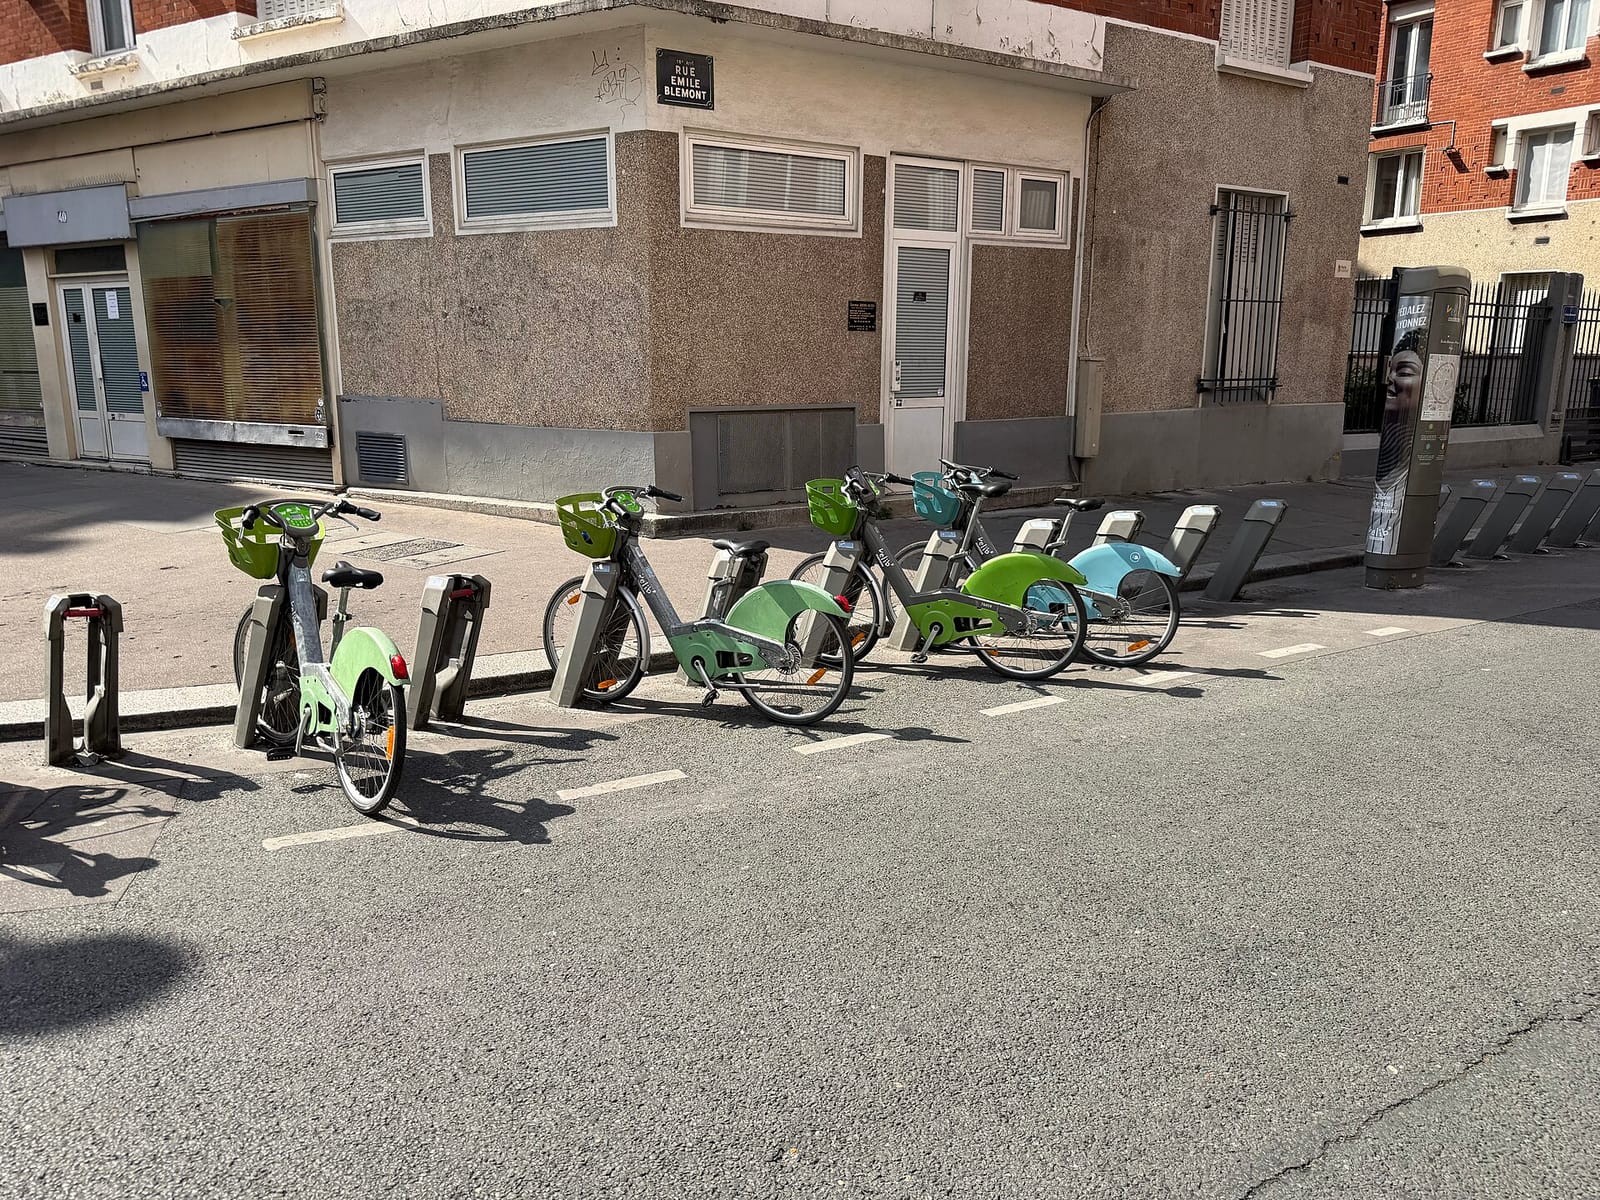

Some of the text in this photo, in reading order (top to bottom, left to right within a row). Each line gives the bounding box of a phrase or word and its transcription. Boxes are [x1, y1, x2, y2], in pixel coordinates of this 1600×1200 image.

[675, 64, 696, 77] RUE
[670, 75, 701, 89] EMILE
[664, 85, 707, 100] BLEMONT
